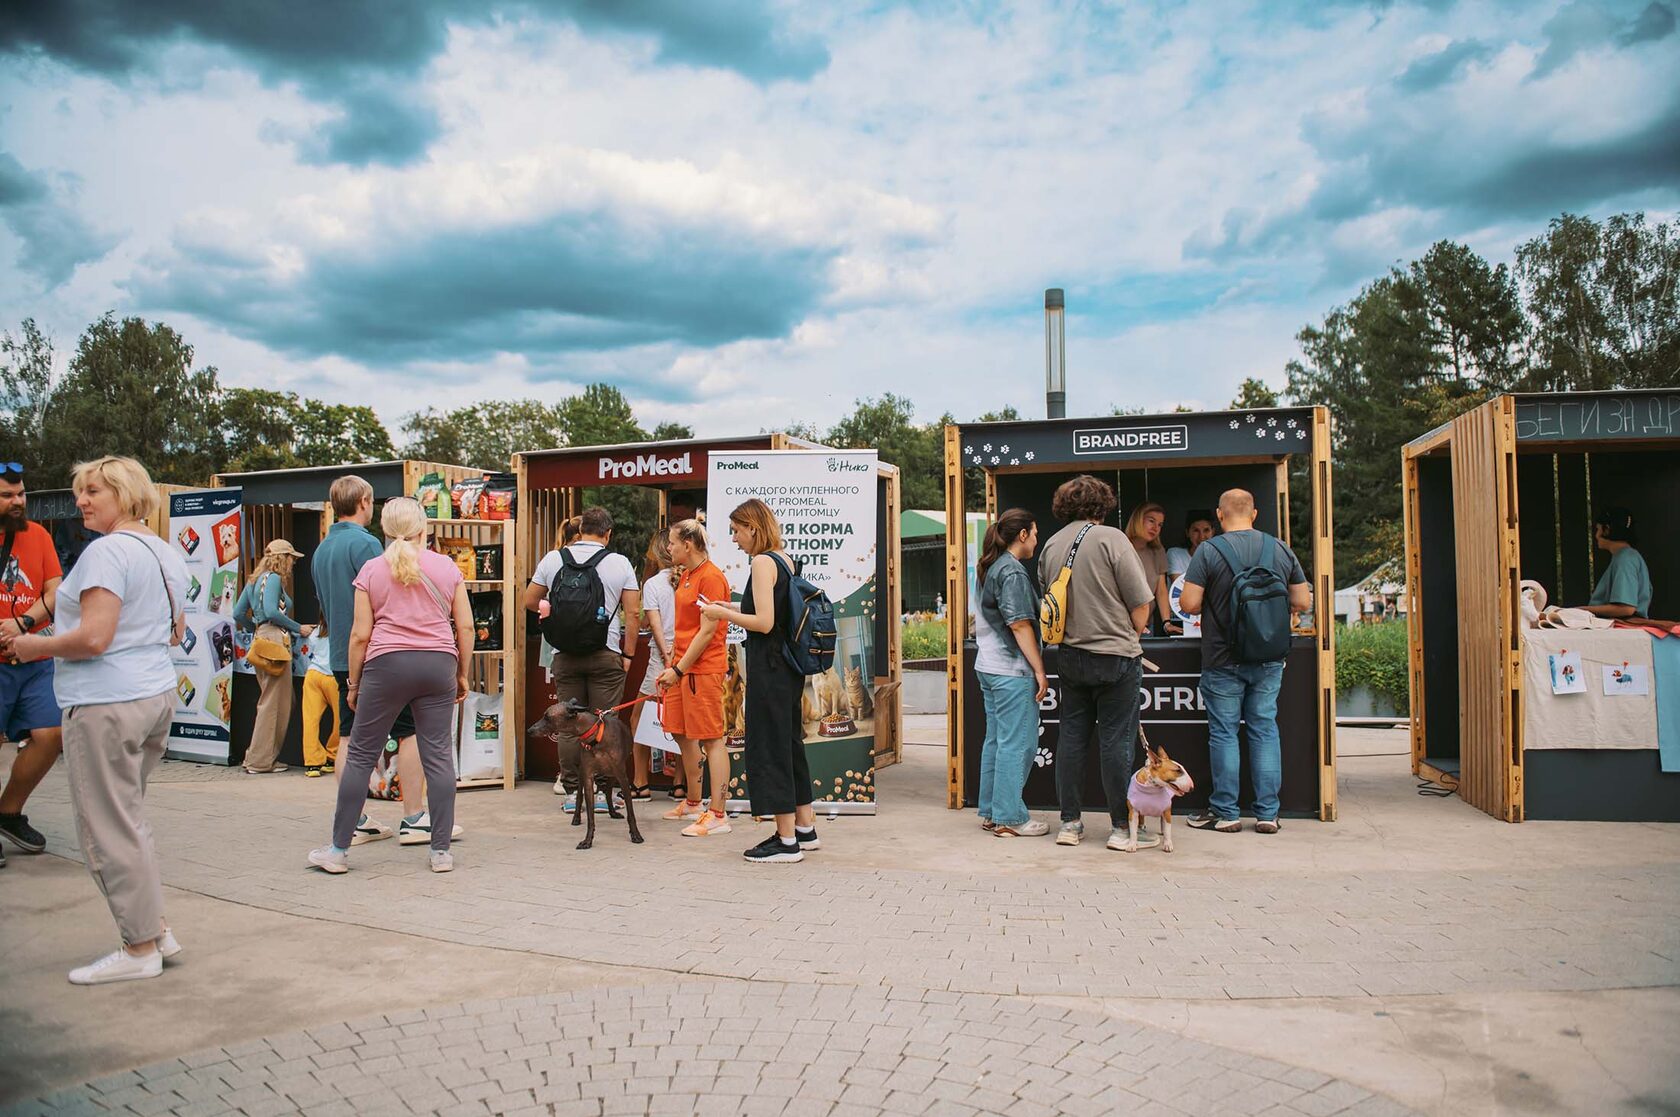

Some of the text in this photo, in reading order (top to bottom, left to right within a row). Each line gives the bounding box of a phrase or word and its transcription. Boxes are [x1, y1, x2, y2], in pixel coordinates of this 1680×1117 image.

[1515, 400, 1600, 438] БЕГИ
[1607, 398, 1635, 434] ЗА
[1080, 431, 1181, 448] BRANDFREE
[599, 452, 693, 479] ProMeal
[717, 461, 759, 470] ProMeal
[839, 460, 869, 472] Ника
[726, 486, 859, 496] С КАЖДОГО КУПЛЕННОГО
[779, 498, 827, 506] PROMEAL
[788, 508, 840, 518] ПИТОМЦУ
[799, 523, 854, 535] КОРМА
[782, 538, 844, 550] ОТНОМУ
[802, 572, 831, 581] ИКА»
